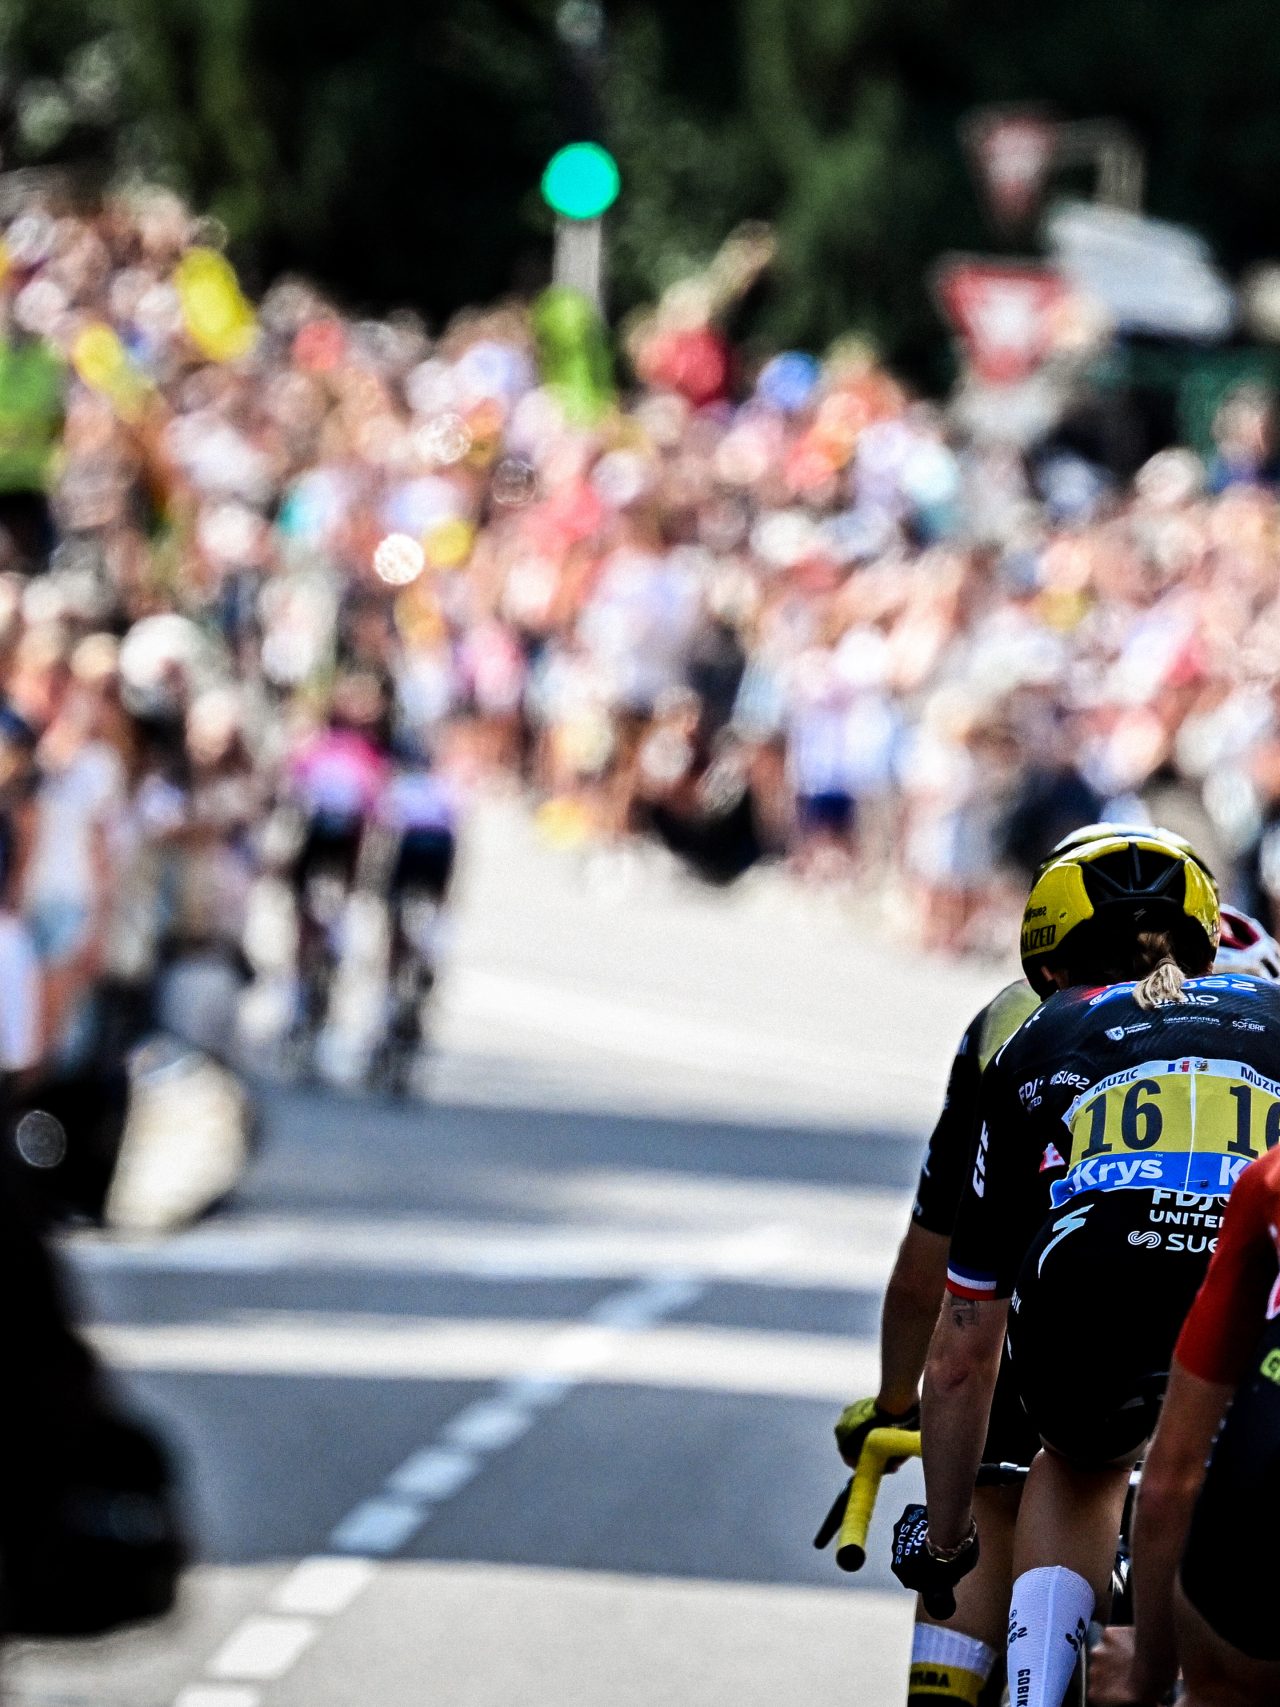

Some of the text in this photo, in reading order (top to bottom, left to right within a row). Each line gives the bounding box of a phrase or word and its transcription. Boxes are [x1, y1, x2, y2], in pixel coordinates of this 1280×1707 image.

[1093, 1068, 1139, 1095] MUZIC
[1080, 1078, 1164, 1160] 16
[1072, 1158, 1164, 1192] Krys
[1151, 1189, 1214, 1212] FDJ
[1016, 1669, 1031, 1707] GOBIK
